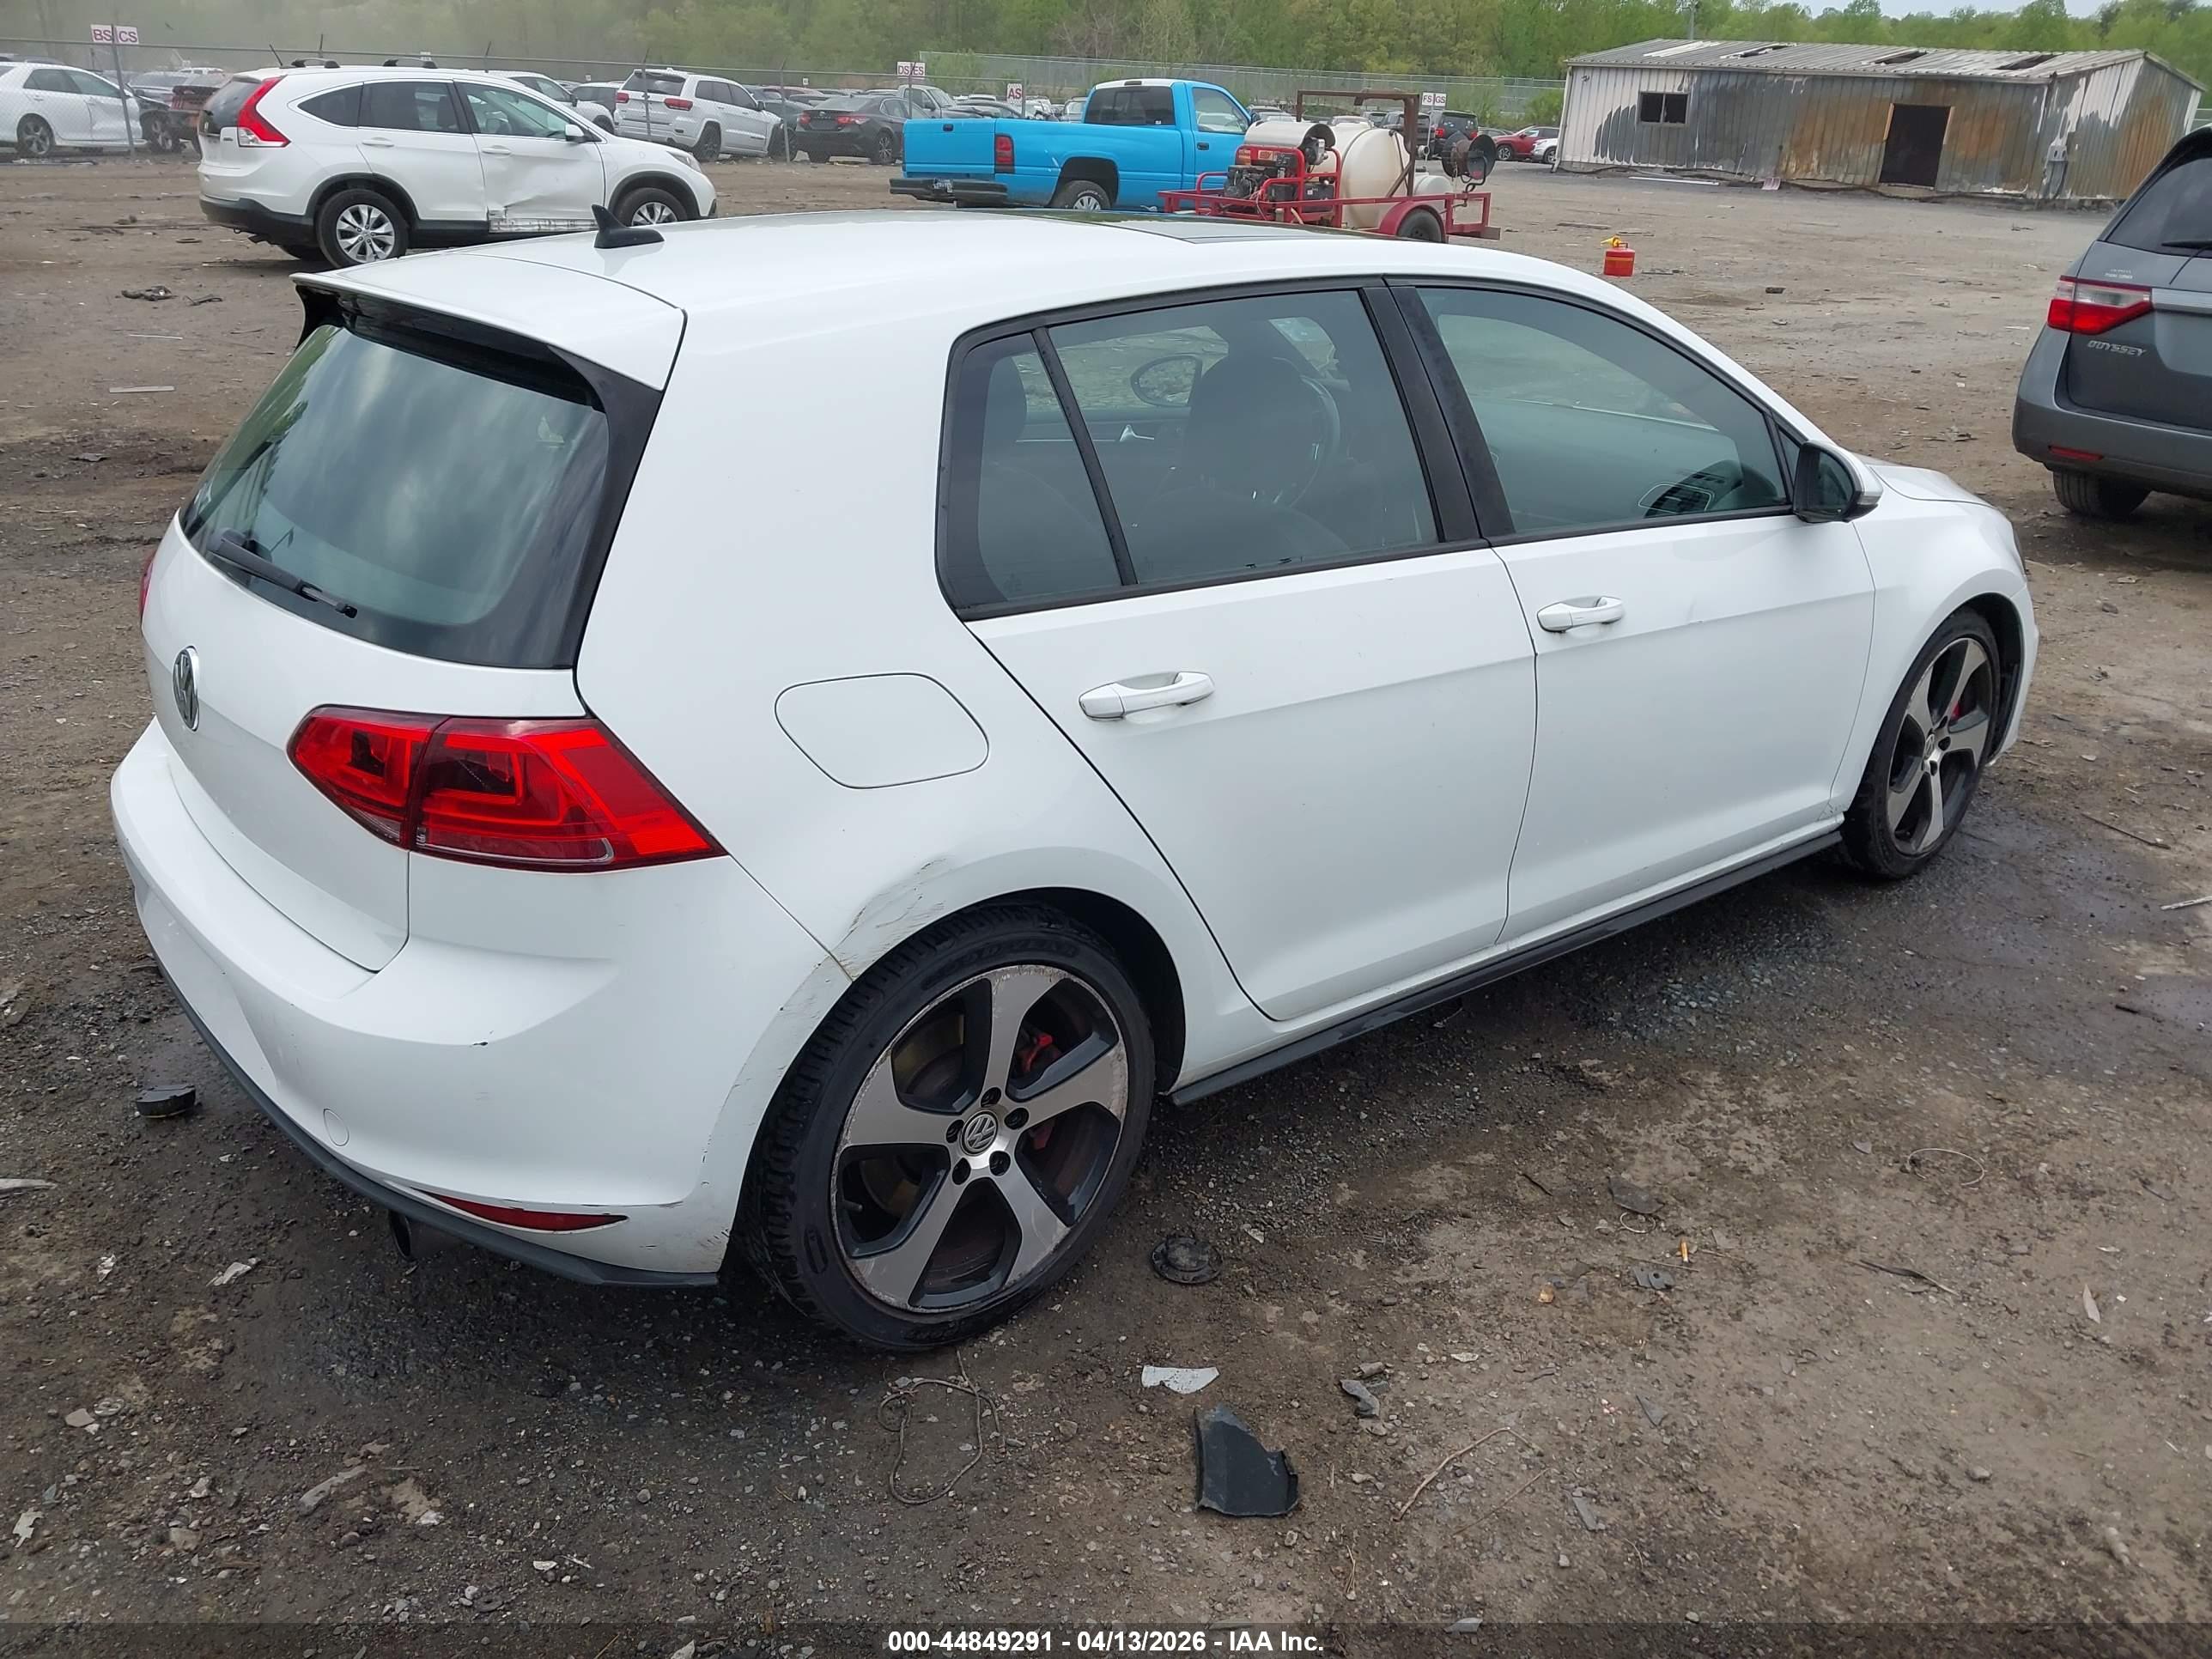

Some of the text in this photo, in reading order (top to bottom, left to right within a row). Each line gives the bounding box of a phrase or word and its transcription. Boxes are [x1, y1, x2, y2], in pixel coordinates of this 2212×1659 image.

[93, 28, 112, 41] BS
[118, 30, 137, 43] CS
[897, 65, 909, 75] DS
[913, 65, 924, 76] ES
[1008, 88, 1022, 100] AS
[1422, 94, 1432, 103] FS
[1435, 95, 1446, 104] GS
[2087, 339, 2147, 356] ODYSSEY
